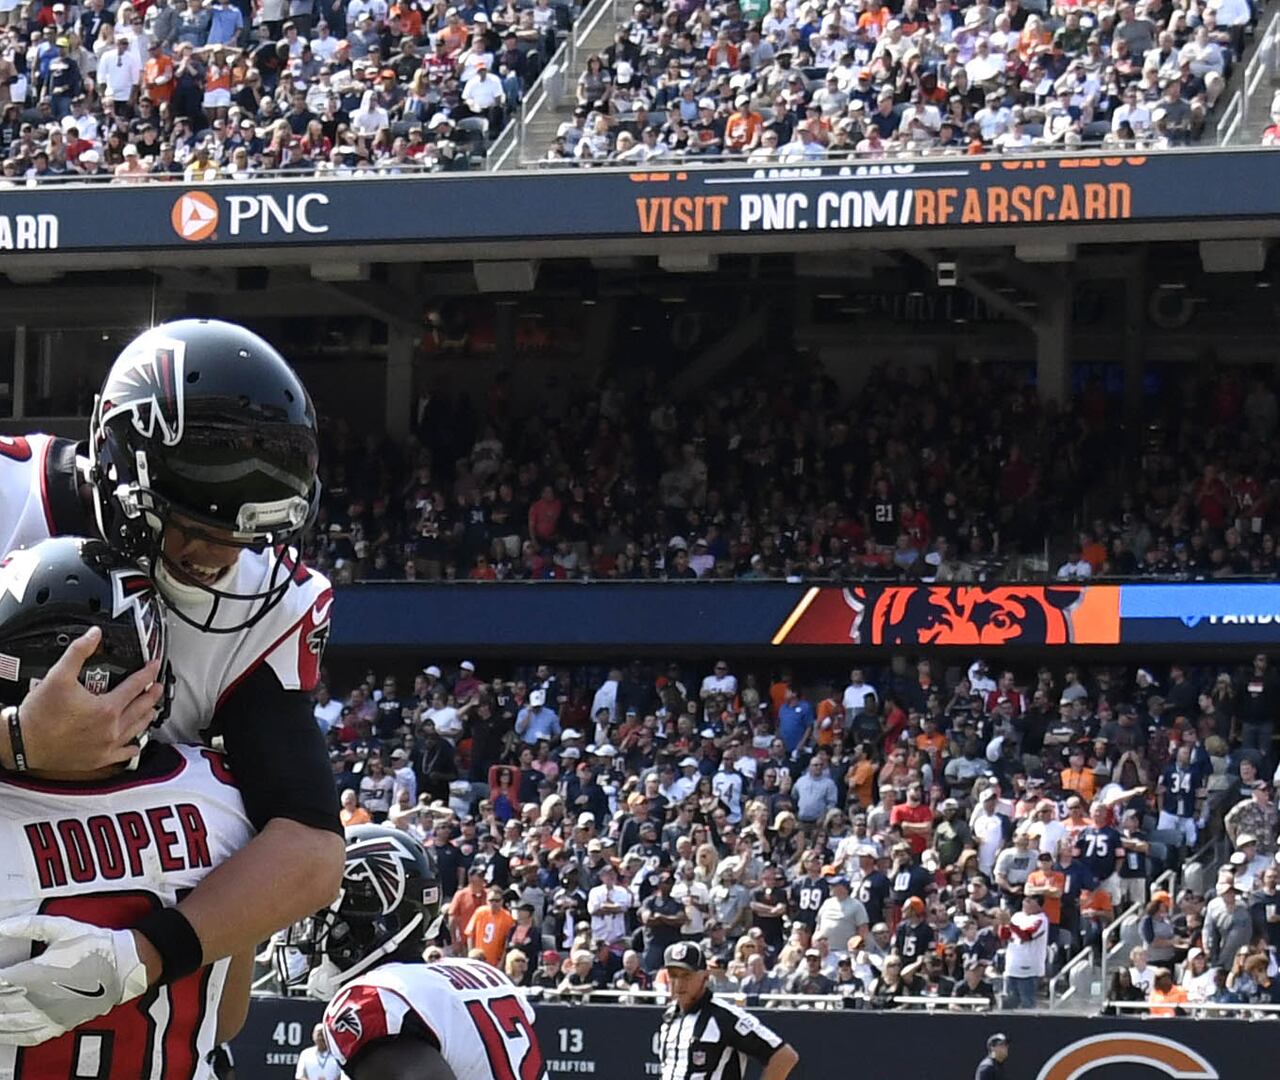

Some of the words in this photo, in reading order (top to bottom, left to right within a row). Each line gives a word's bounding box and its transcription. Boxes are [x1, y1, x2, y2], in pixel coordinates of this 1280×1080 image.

[225, 192, 329, 235] PNC
[635, 196, 729, 234] VISIT
[875, 504, 894, 522] 21
[1171, 774, 1191, 793] 34
[24, 802, 212, 889] HOOPER
[1085, 835, 1109, 857] 75
[800, 888, 822, 910] 89
[272, 1021, 301, 1045] 40
[558, 1028, 583, 1052] 13
[546, 1060, 595, 1072] TRAFTON
